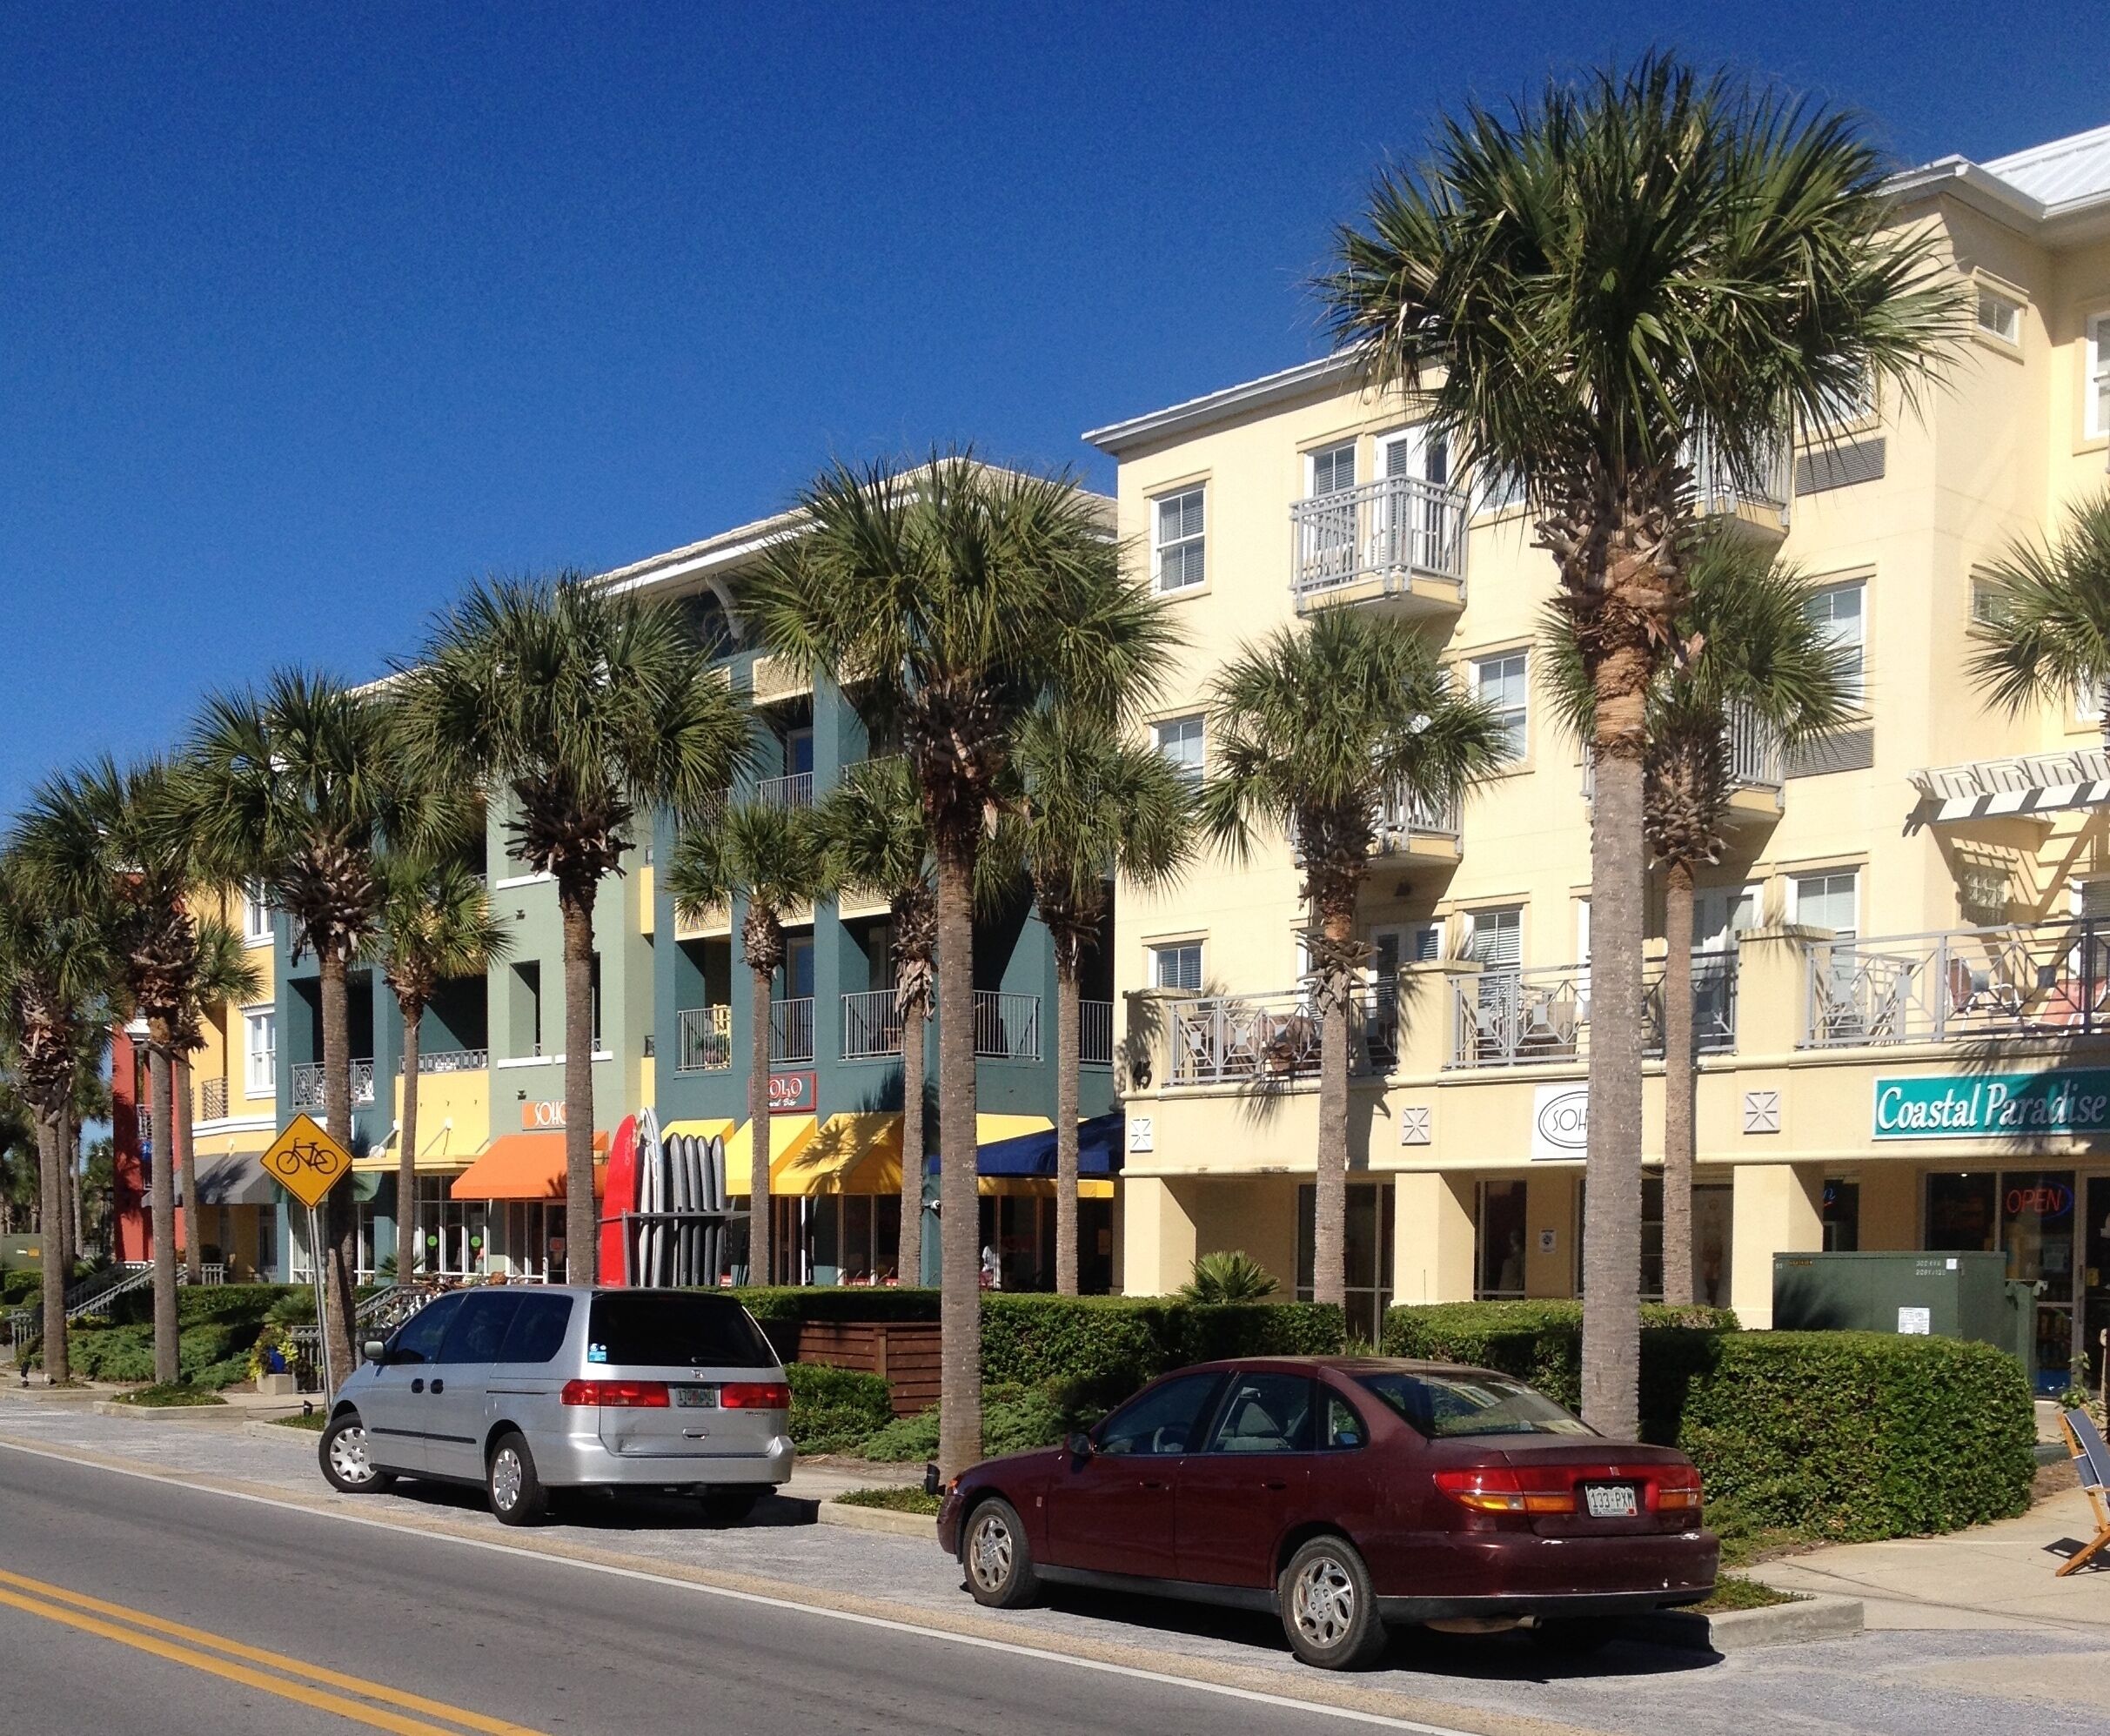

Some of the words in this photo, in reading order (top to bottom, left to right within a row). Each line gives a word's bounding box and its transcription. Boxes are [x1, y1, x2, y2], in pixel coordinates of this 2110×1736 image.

[1878, 1082, 1981, 1129] Coastal
[1984, 1079, 2107, 1126] Paradise
[1552, 1108, 1589, 1132] SOH
[2006, 1189, 2061, 1213] OPEN
